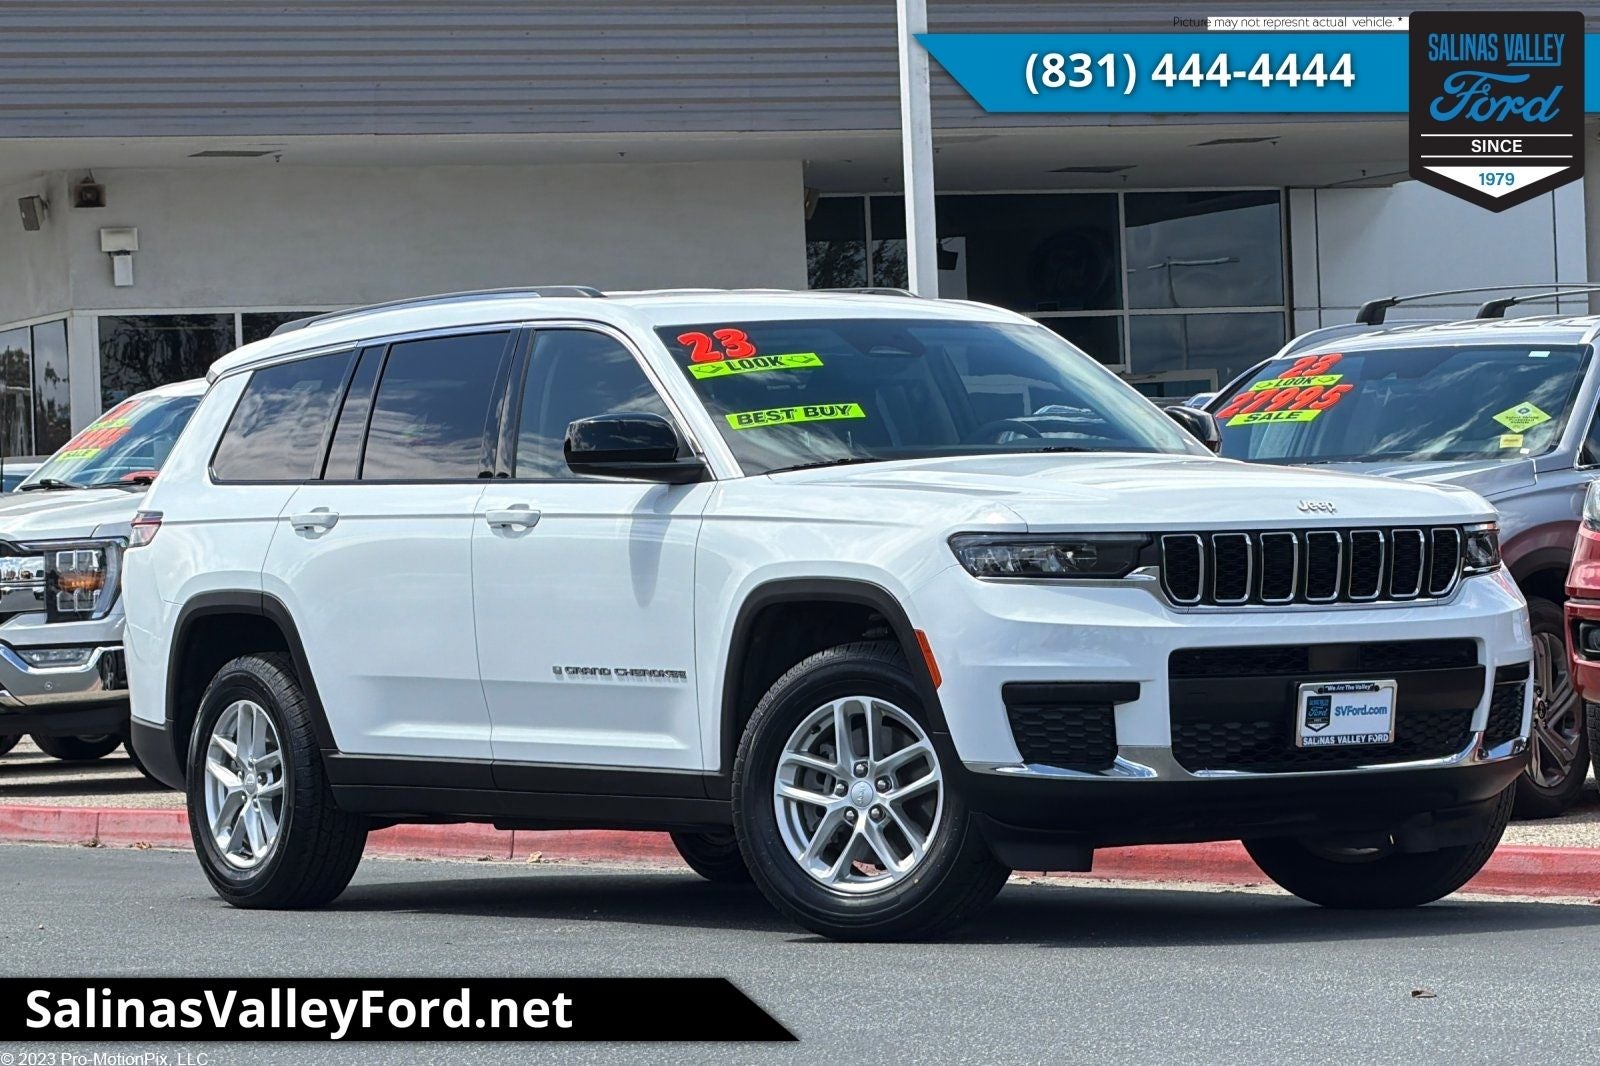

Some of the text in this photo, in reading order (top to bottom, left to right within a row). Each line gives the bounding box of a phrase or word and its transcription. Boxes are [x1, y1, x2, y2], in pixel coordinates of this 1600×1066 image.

[677, 328, 757, 363] 23
[725, 355, 786, 372] LOOK
[1279, 353, 1343, 378] 23
[1273, 376, 1317, 388] LOOK
[736, 404, 852, 426] BEST BUY
[1243, 411, 1304, 423] SALE
[1297, 499, 1338, 515] Jeep
[564, 666, 687, 679] GRAND CHEROKEE
[1334, 704, 1388, 717] SVFord.com
[1303, 733, 1389, 746] SALINAS VALLEY FORD
